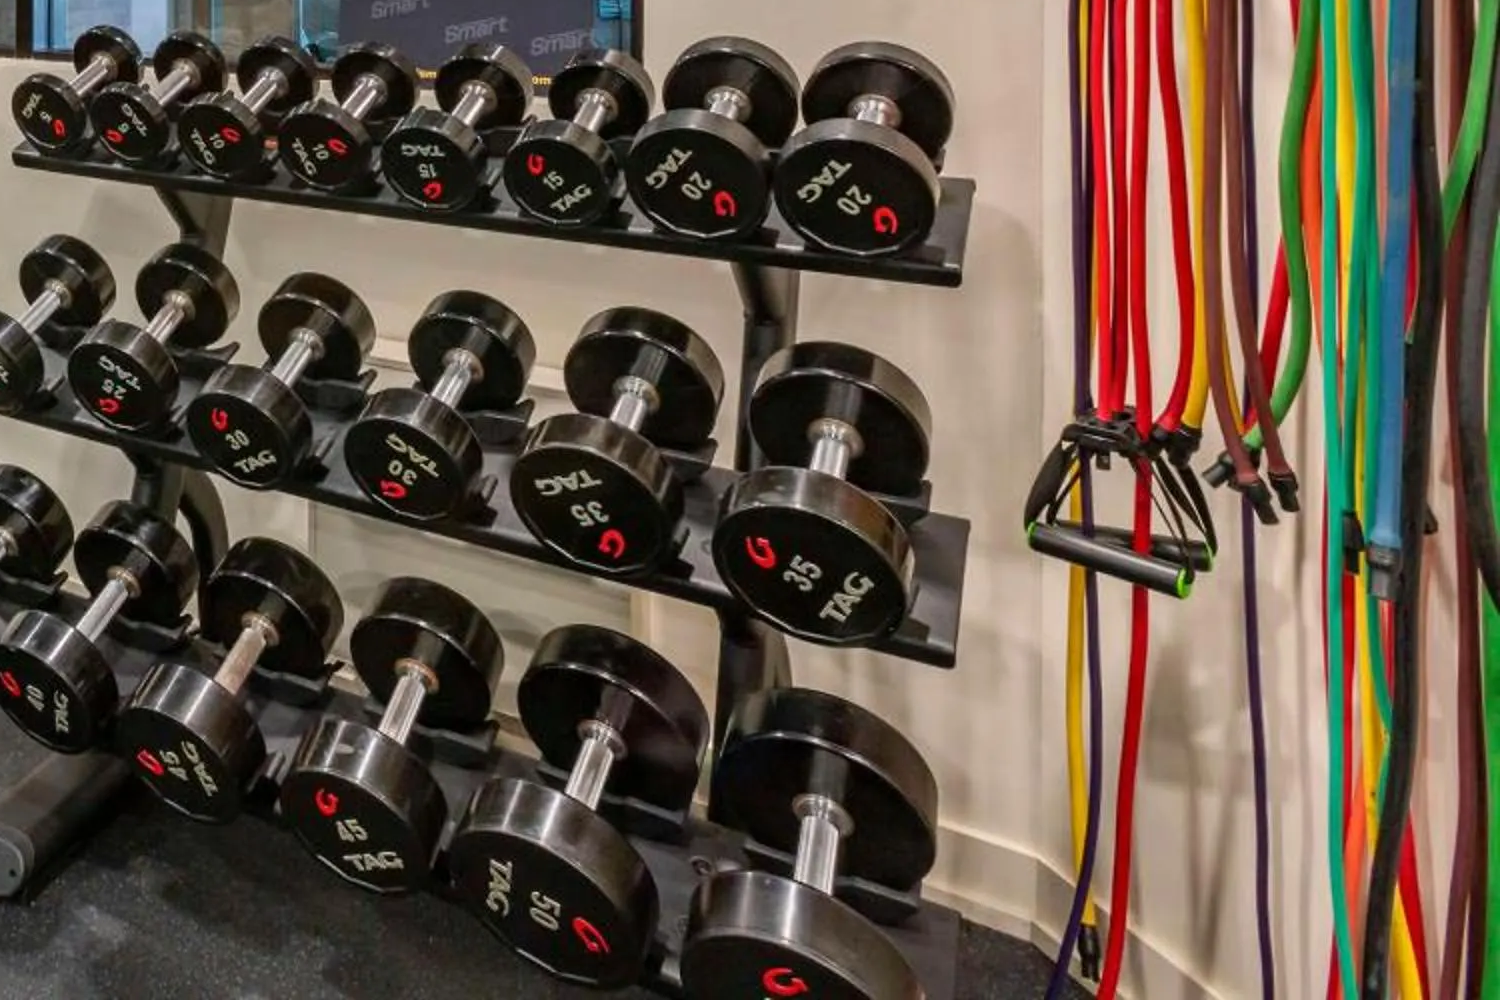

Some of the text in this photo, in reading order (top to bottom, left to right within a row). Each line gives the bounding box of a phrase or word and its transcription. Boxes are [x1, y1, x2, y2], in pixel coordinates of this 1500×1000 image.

[445, 16, 510, 44] Smart
[531, 30, 592, 56] Smar
[121, 102, 150, 137] TAG
[292, 138, 318, 177] TAG
[312, 144, 330, 162] 10
[401, 143, 446, 158] TAG
[418, 162, 438, 180] 15
[543, 170, 565, 191] 15
[646, 146, 693, 190] TAG
[797, 158, 853, 205] TAG
[549, 182, 594, 214] TAG
[680, 171, 714, 201] 20
[836, 184, 873, 217] 20
[98, 354, 142, 392] TAG
[225, 429, 250, 451] 30
[233, 449, 278, 475] TAG
[384, 432, 441, 479] TAG
[387, 459, 418, 487] 30
[534, 467, 604, 497] TAG
[569, 500, 611, 529] 35
[782, 554, 823, 593] 35
[818, 569, 876, 625] TAG
[334, 818, 369, 844] 45
[342, 850, 405, 873] TAG
[485, 857, 514, 920] TAG
[528, 889, 562, 932] 50
